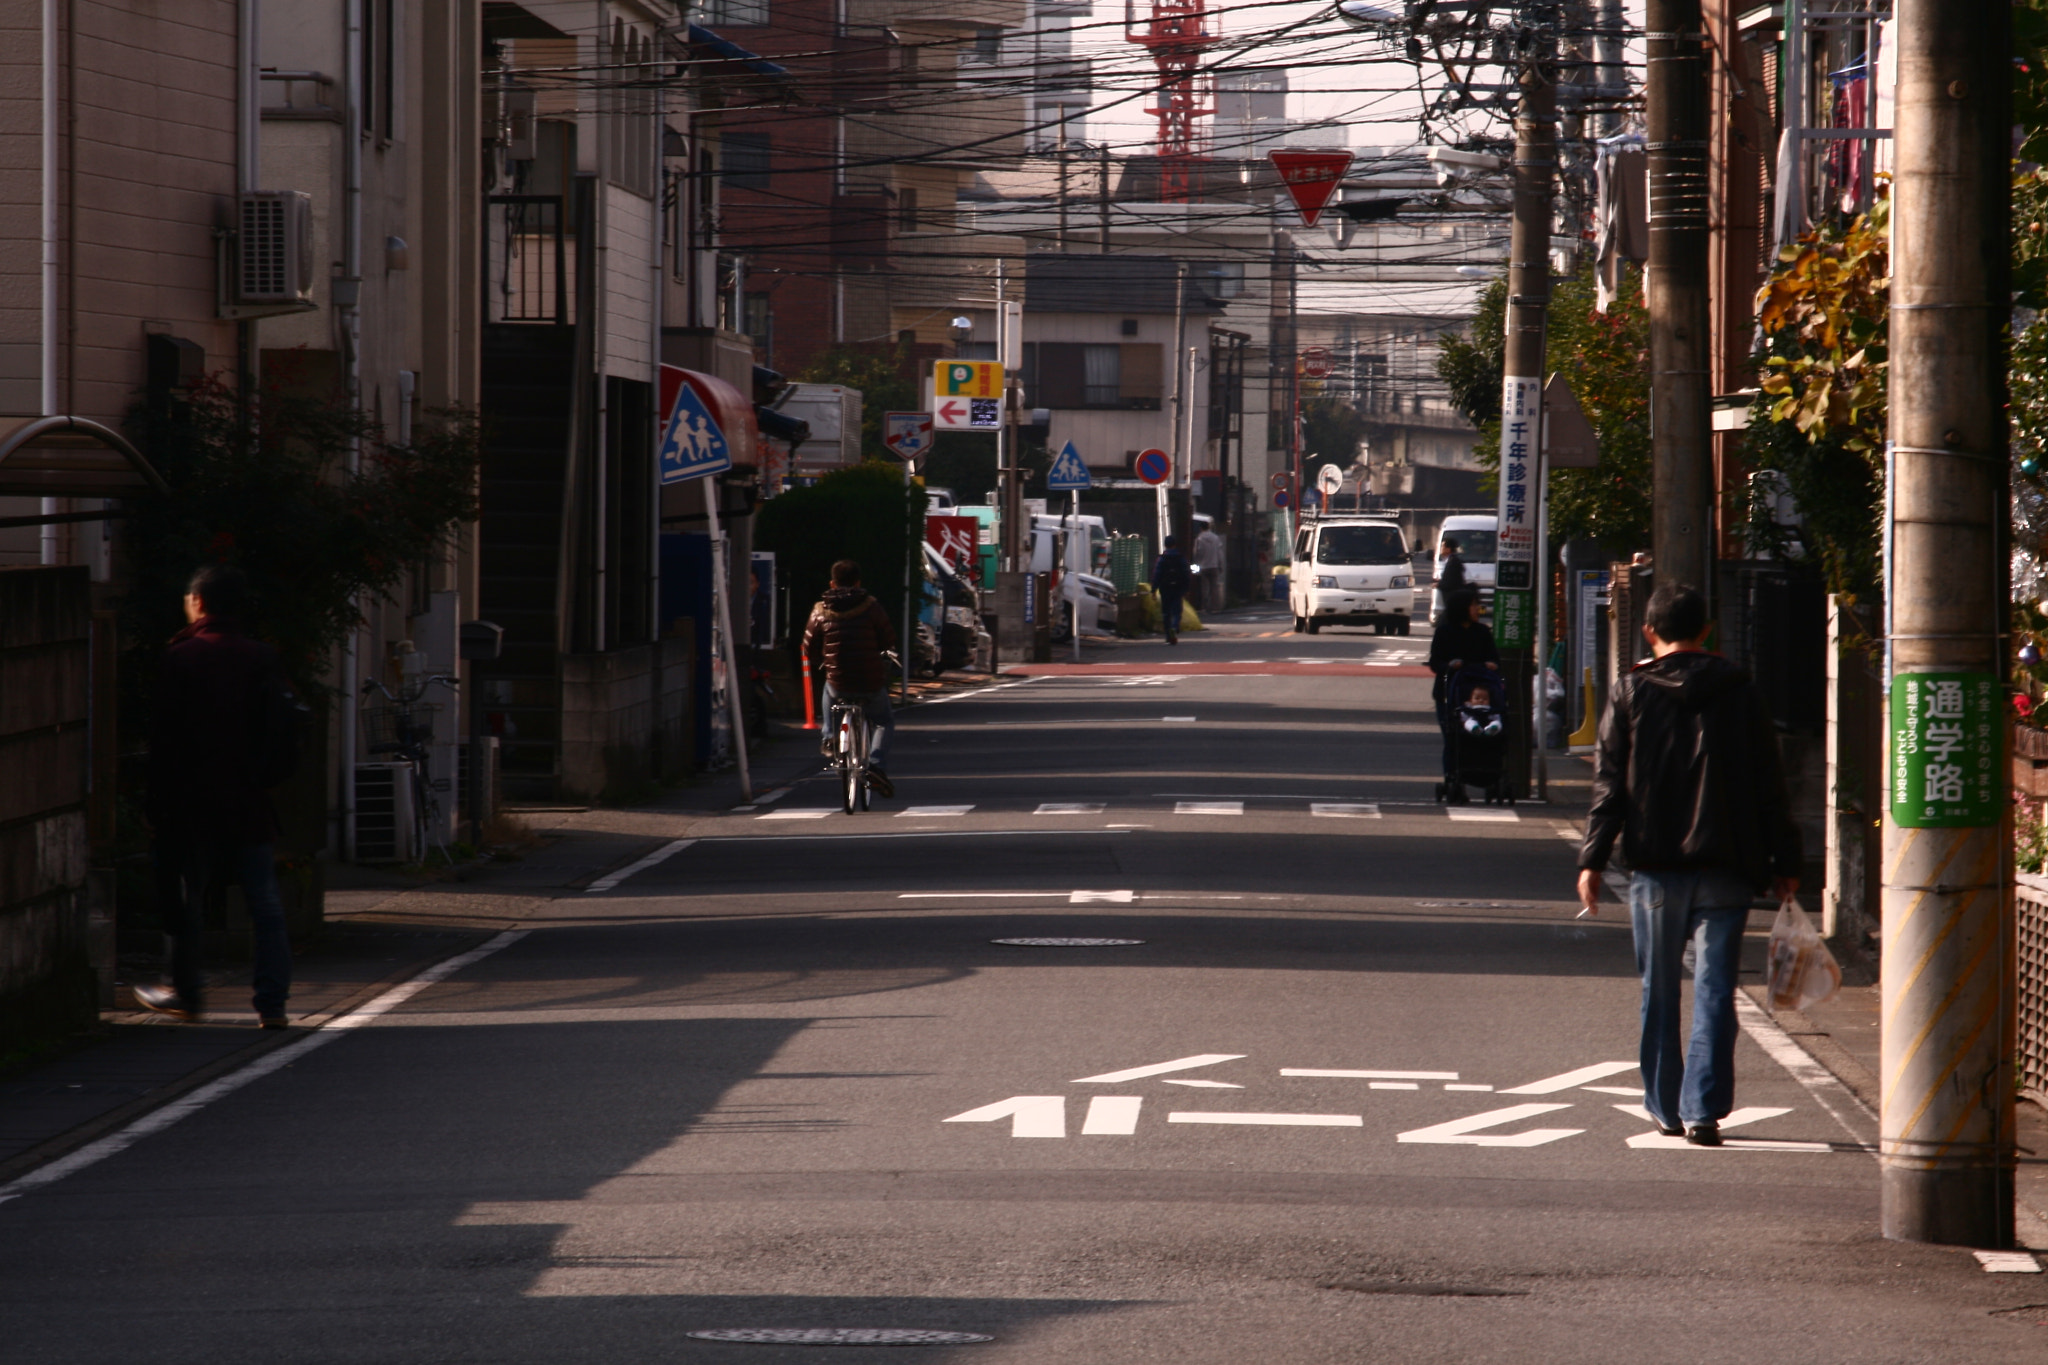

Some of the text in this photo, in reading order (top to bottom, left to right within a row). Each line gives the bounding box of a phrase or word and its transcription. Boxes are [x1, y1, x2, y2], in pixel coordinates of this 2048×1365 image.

[1287, 166, 1335, 182] 止まれ
[948, 364, 974, 395] P
[1506, 422, 1529, 524] 千年診療所
[1504, 594, 1520, 640] 通学路
[1906, 681, 1919, 754] 地域で守ろう
[1924, 680, 1965, 803] 通学路
[1897, 730, 1908, 803] こどもの安全
